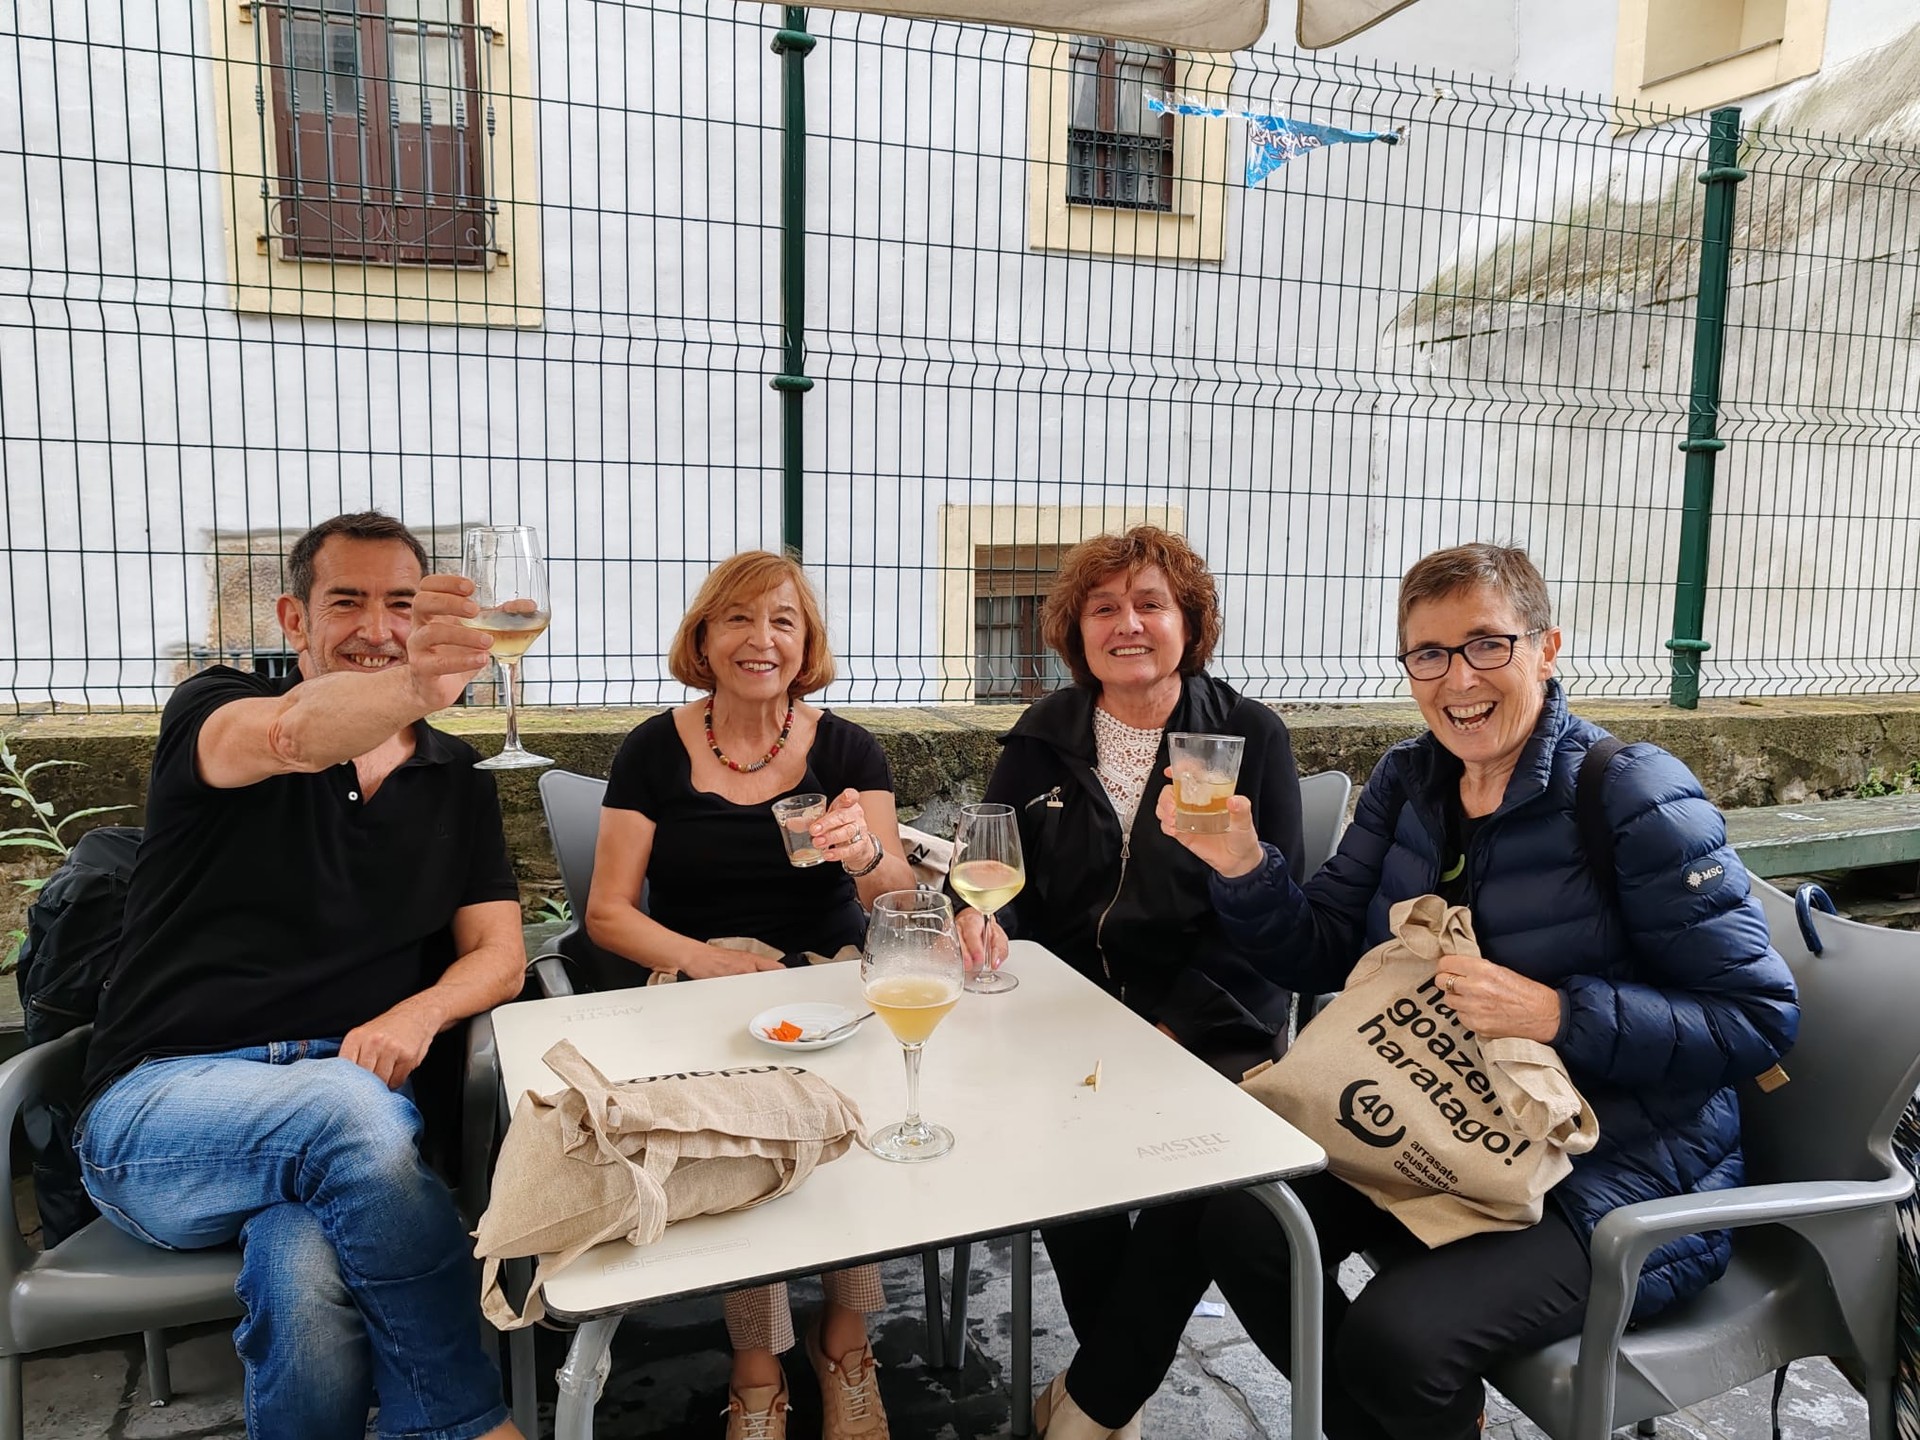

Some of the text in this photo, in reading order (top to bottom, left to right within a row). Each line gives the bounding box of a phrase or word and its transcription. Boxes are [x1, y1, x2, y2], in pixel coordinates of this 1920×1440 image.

[1701, 865, 1723, 880] MSC
[1357, 1013, 1531, 1166] haratago!
[1357, 1094, 1395, 1127] 40
[1136, 1132, 1231, 1158] AMSTEL
[1410, 1140, 1459, 1185] arrasate
